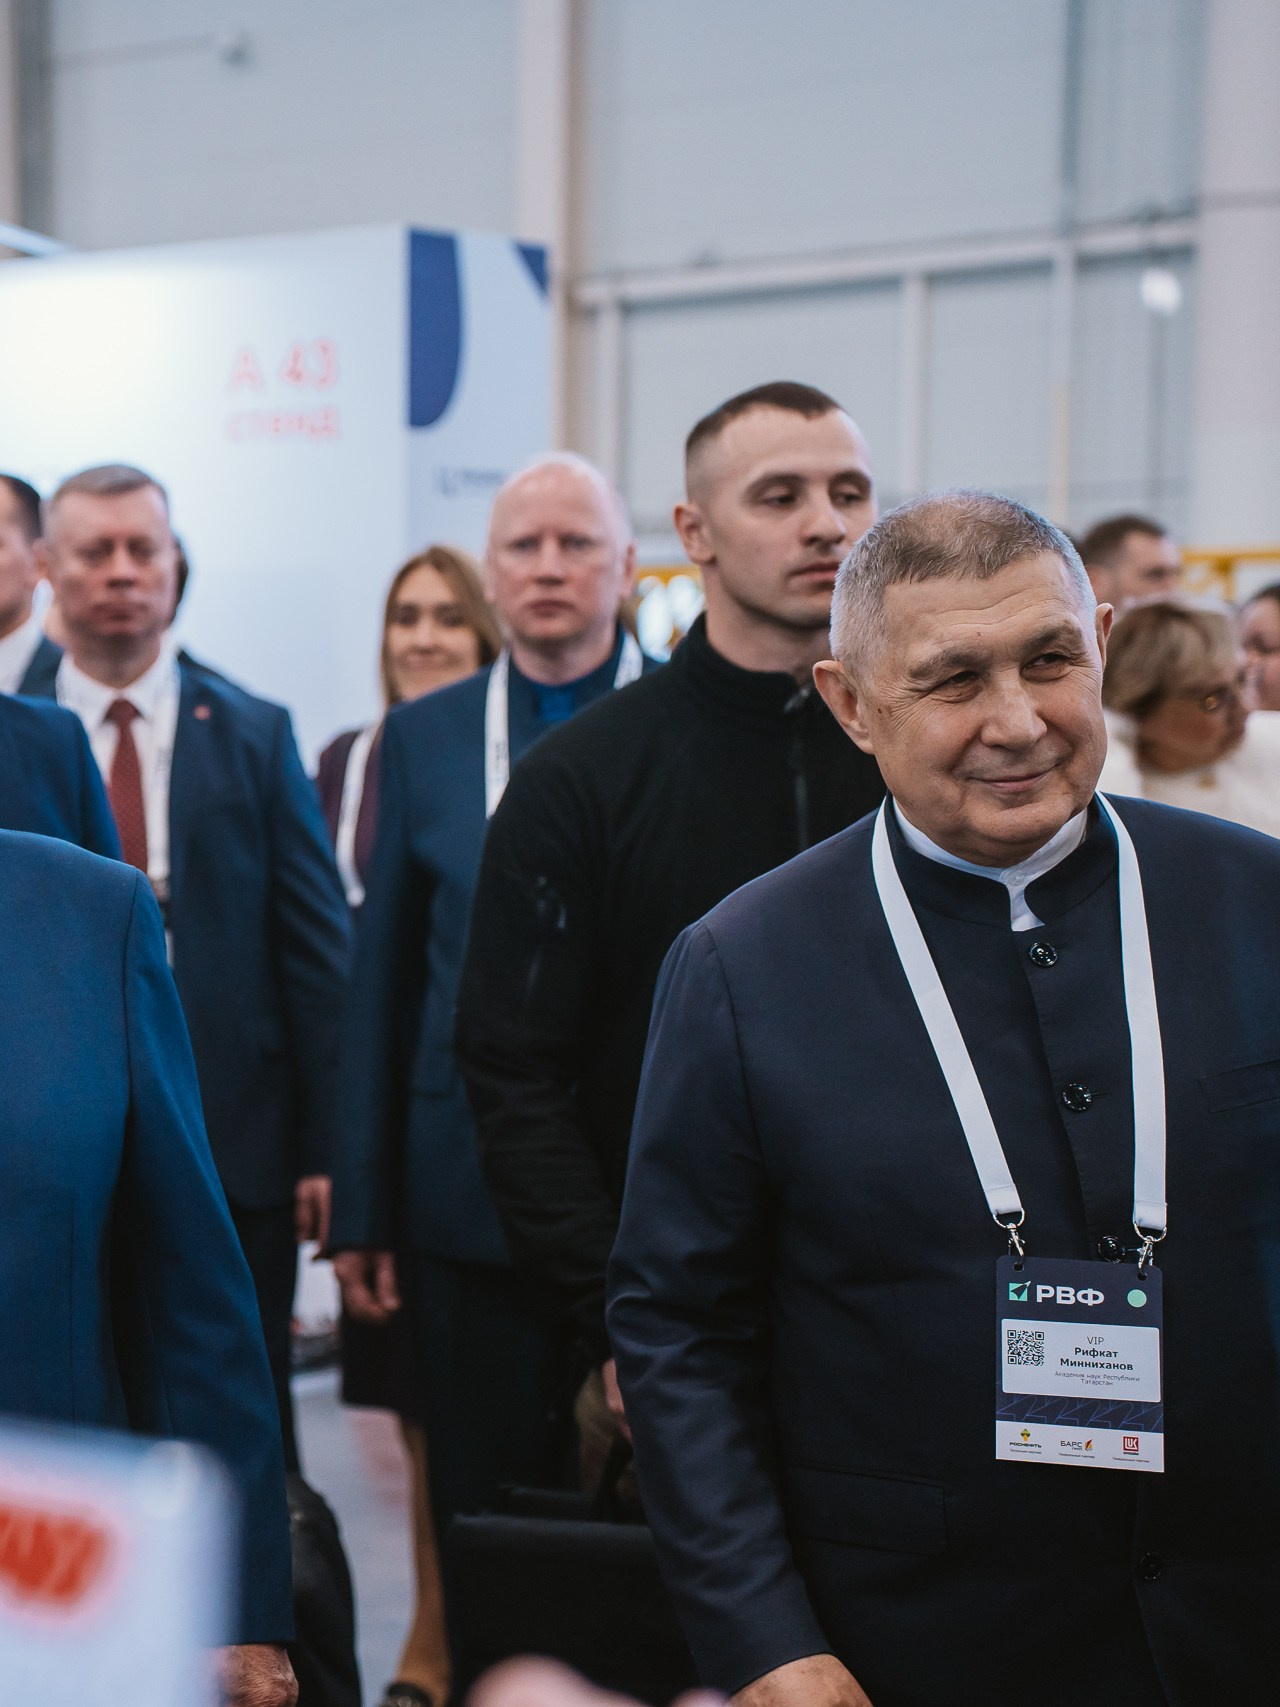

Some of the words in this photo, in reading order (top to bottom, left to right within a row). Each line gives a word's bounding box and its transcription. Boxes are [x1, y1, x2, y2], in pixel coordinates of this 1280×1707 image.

[278, 336, 338, 391] 43
[1036, 1284, 1105, 1306] РВФ
[1086, 1336, 1105, 1345] VIP
[1074, 1347, 1119, 1358] Рифкат
[1060, 1358, 1134, 1371] Минниханов
[1060, 1440, 1083, 1448] БАРС
